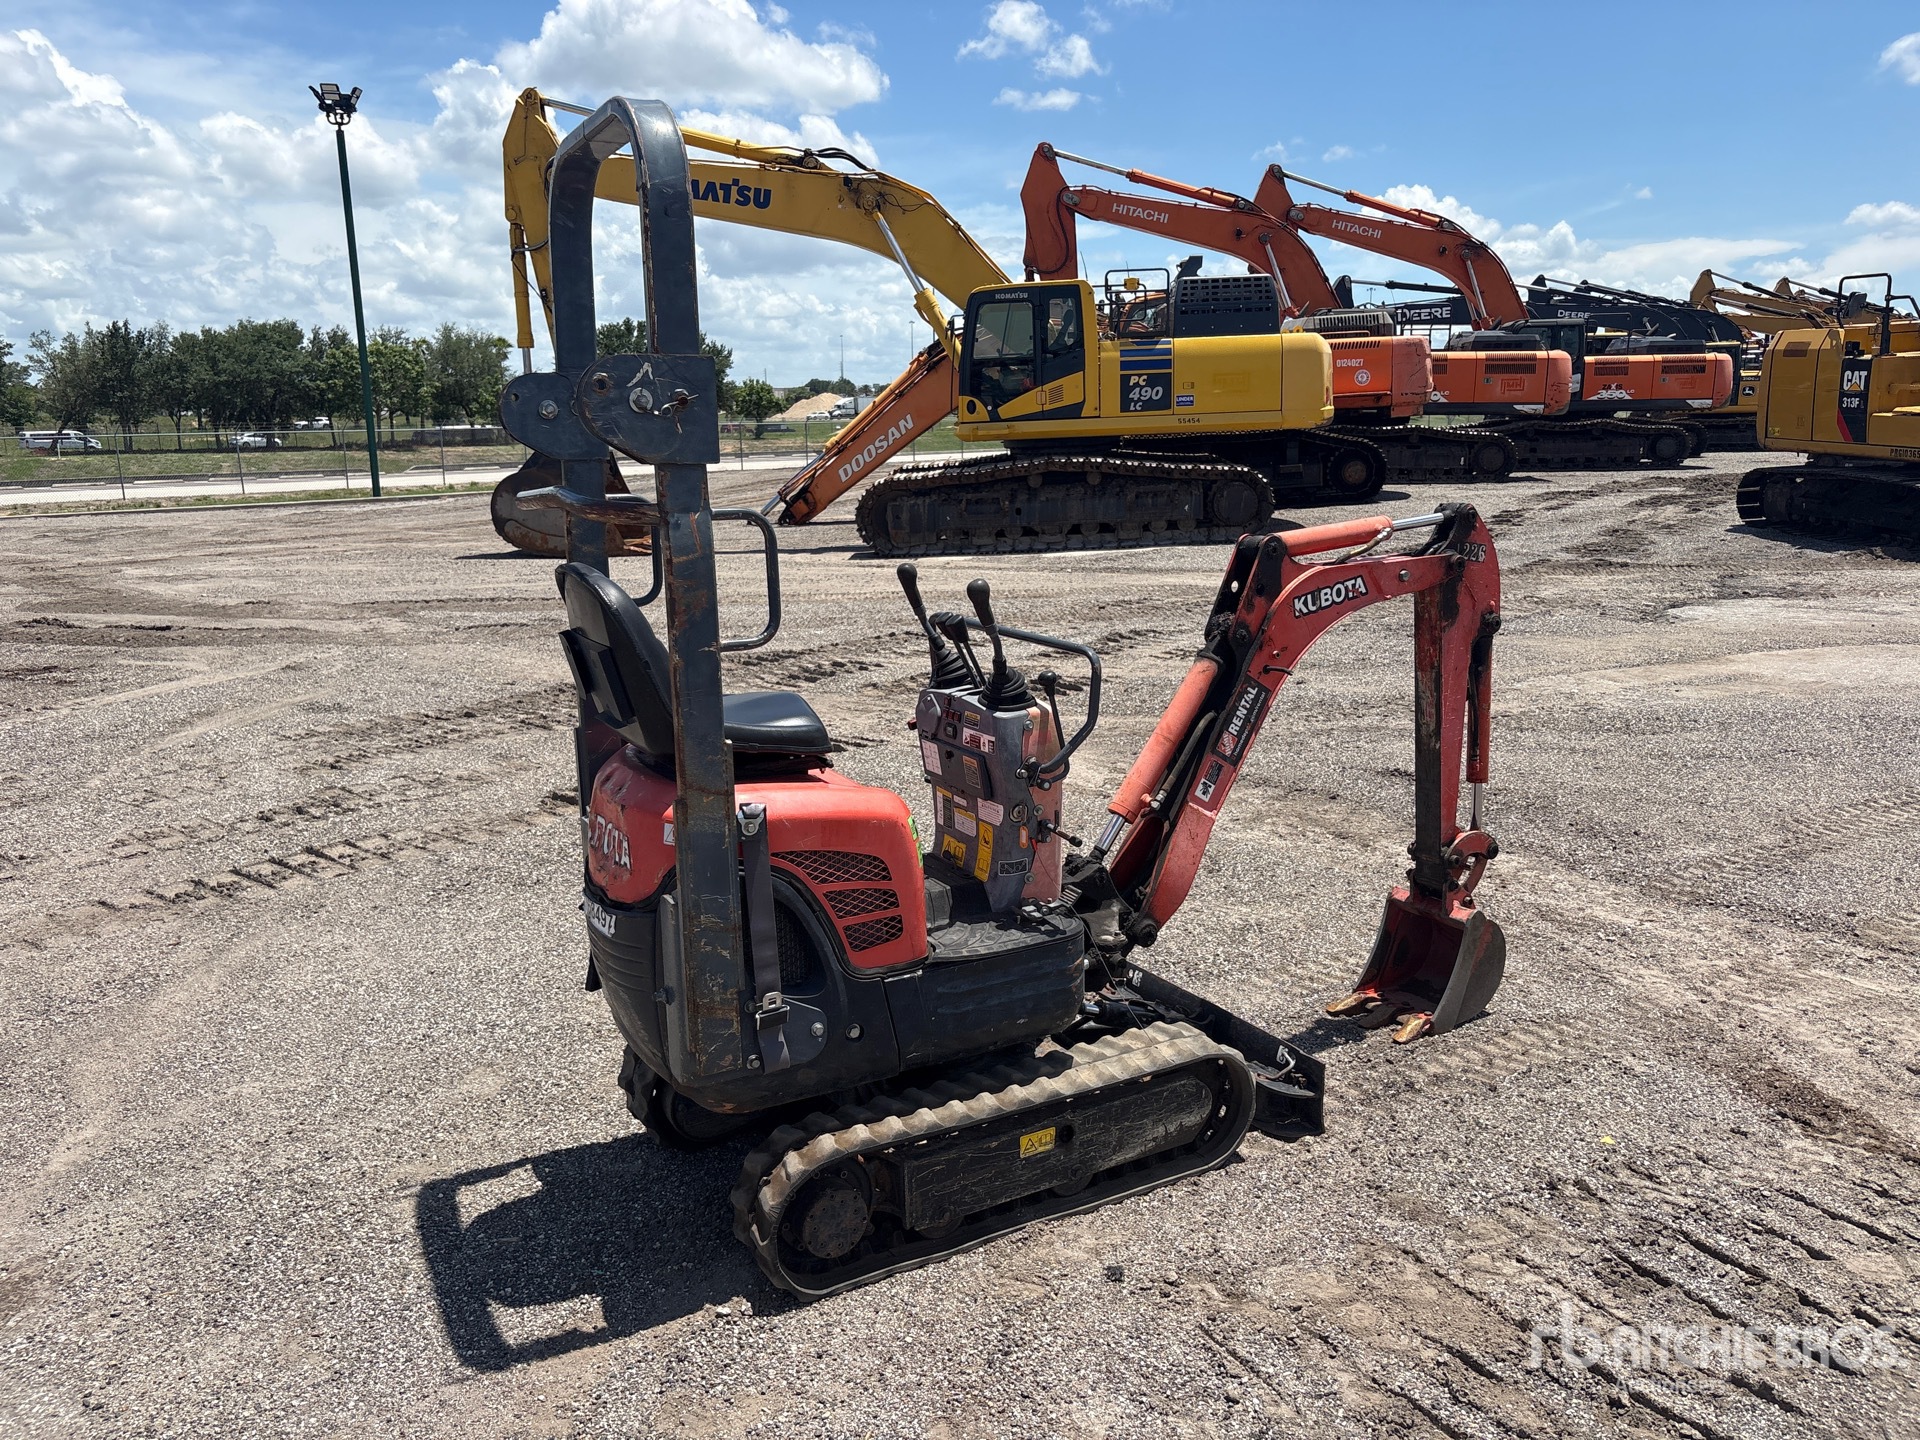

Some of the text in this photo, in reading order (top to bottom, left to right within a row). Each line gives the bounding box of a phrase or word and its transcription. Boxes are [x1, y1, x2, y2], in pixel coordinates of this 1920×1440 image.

[1111, 202, 1169, 224] HITACHI
[1331, 219, 1382, 239] HITACHI
[995, 291, 1028, 300] KOMATSU
[1396, 306, 1452, 322] DEERE
[1336, 358, 1364, 367] 0124027
[1129, 375, 1148, 386] PC
[1843, 370, 1868, 391] CAT
[1128, 386, 1163, 401] 490
[1597, 390, 1626, 400] 350
[1129, 402, 1143, 411] LC
[1842, 397, 1860, 408] 313F
[838, 413, 914, 483] DOOSAN
[1293, 576, 1368, 617] KUBOTA
[1228, 685, 1259, 736] RENTAL
